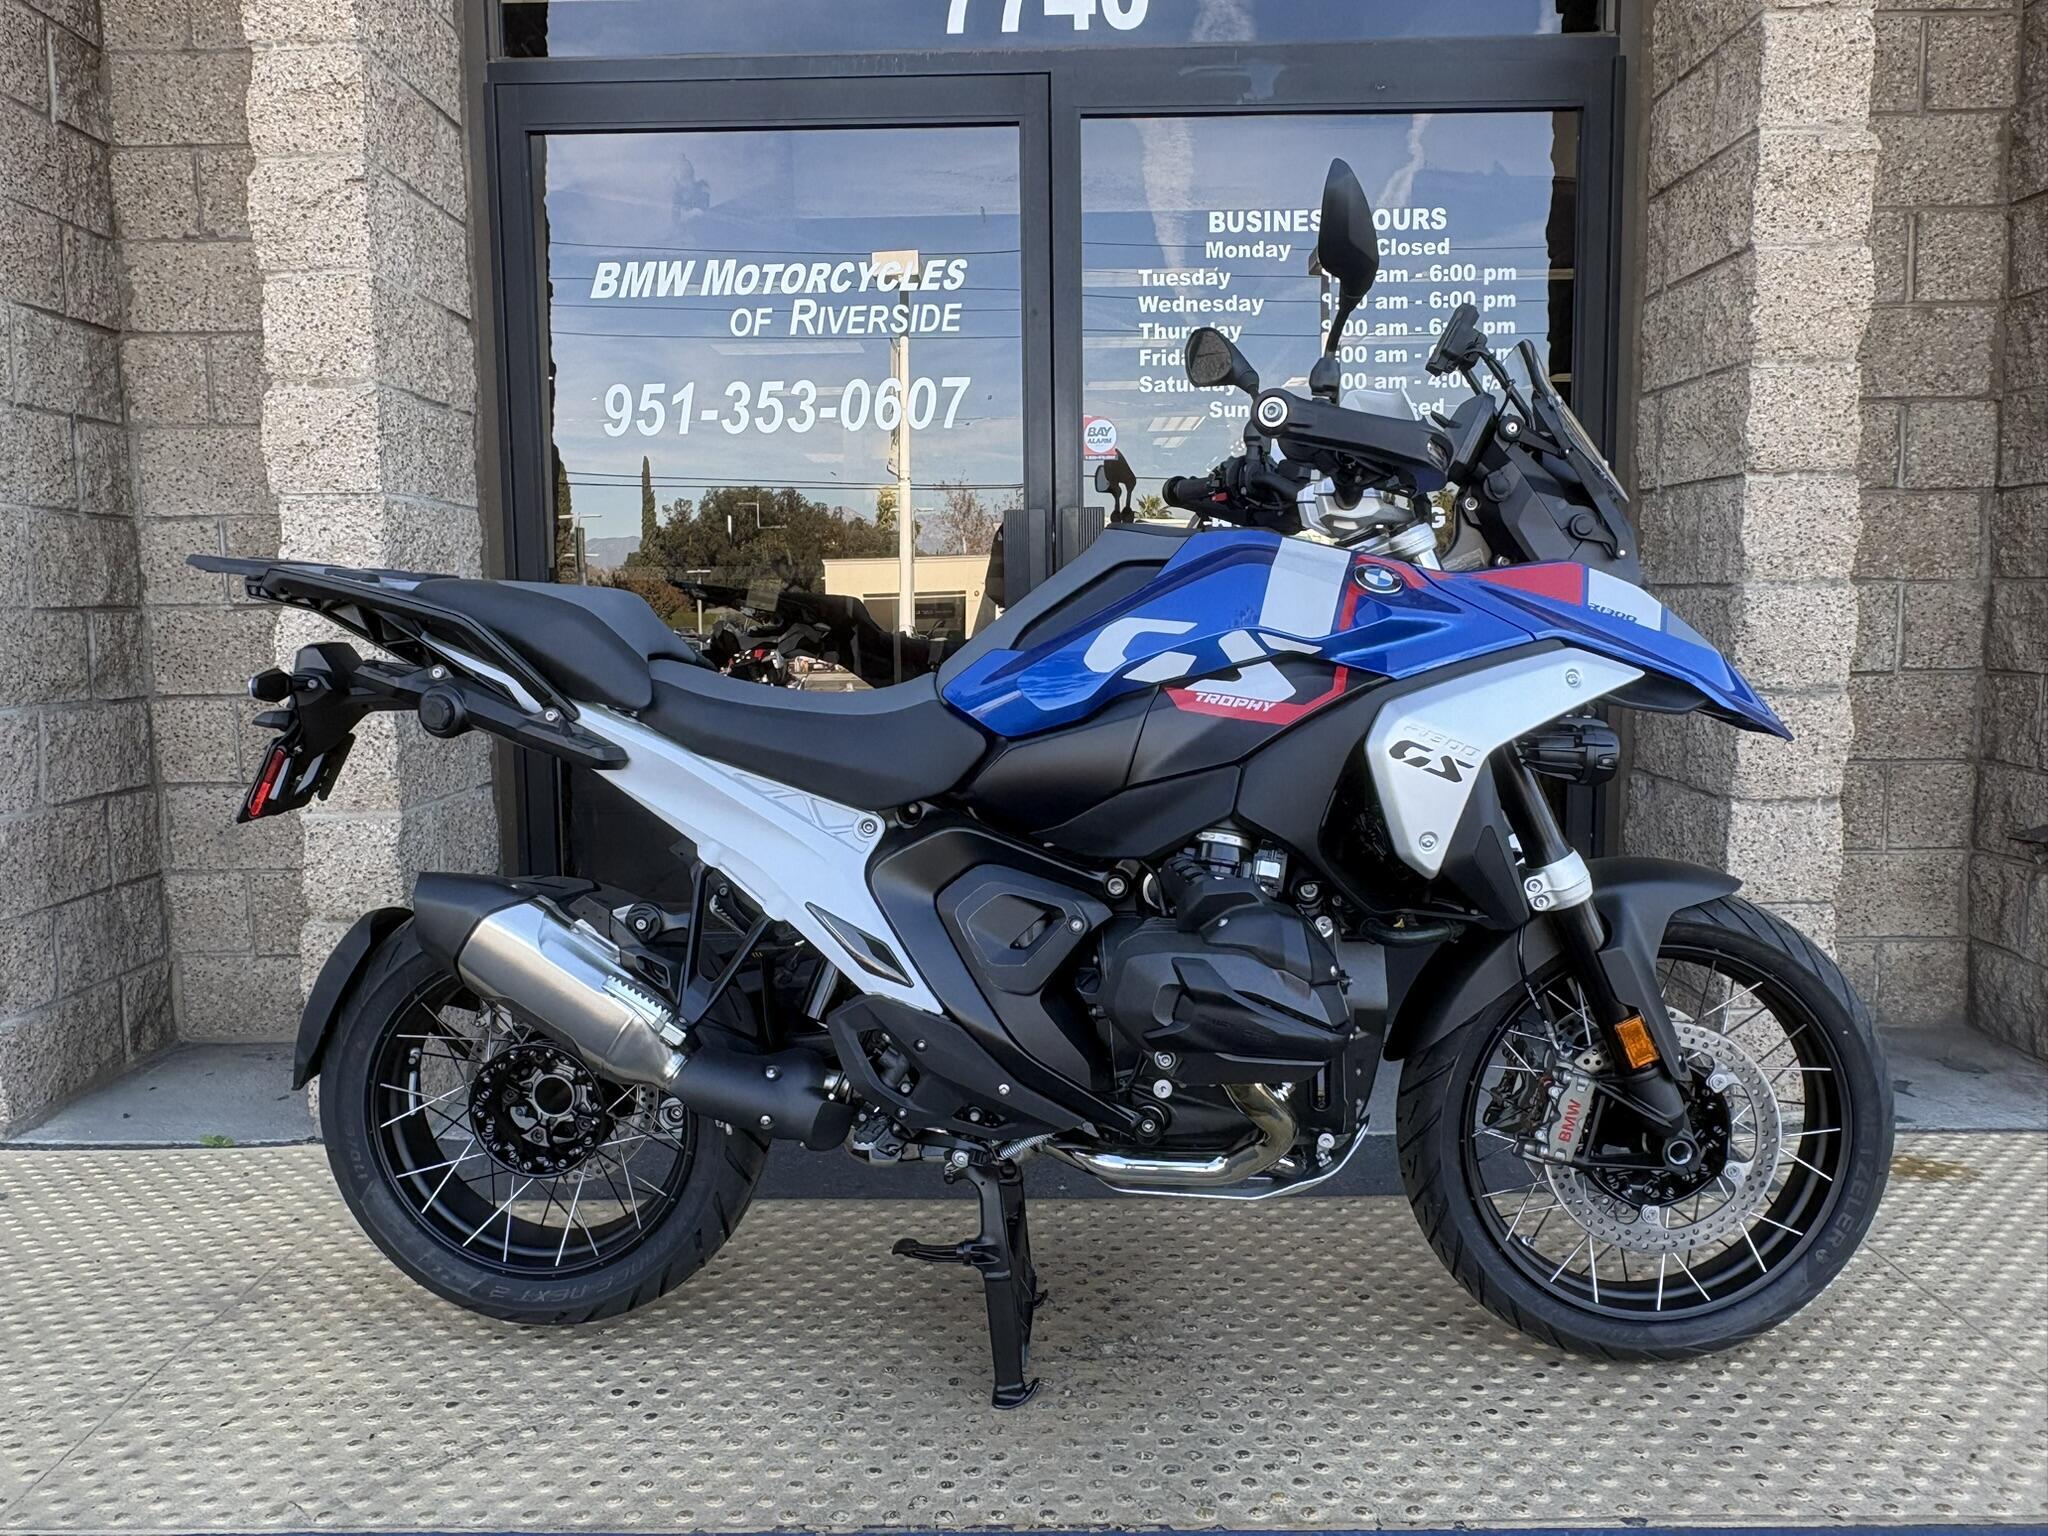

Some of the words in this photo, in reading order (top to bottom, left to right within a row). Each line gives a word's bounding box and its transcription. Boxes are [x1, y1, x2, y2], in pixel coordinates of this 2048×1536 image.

[1208, 210, 1321, 233] BUSINES
[1372, 207, 1447, 231] OURS
[1205, 240, 1291, 261] Monday
[1377, 238, 1450, 256] Closed
[590, 260, 697, 299] BMW
[699, 258, 968, 296] MOTORCYCLES
[1138, 268, 1231, 290] Tuesday
[1375, 269, 1408, 283] am
[1429, 264, 1476, 282] 6:00
[1483, 267, 1517, 285] pm
[1138, 295, 1265, 316] Wednesday
[1321, 293, 1368, 310] 9:0
[1375, 296, 1408, 310] am
[1429, 291, 1476, 309] 6:00
[1483, 293, 1517, 312] pm
[729, 307, 773, 337] OF
[789, 299, 963, 336] RIVERSIDE
[1138, 322, 1242, 343] Thuray
[1321, 319, 1368, 337] 900
[1374, 322, 1408, 336] am
[1483, 320, 1516, 337] pm
[1139, 349, 1185, 366] Frid
[1335, 346, 1368, 364] :00
[1374, 349, 1408, 363] am
[1374, 376, 1407, 390] am
[603, 377, 971, 437] 951-353-0607
[1209, 401, 1250, 418] Sun
[1087, 426, 1112, 437] BAY
[1195, 692, 1277, 712] TROPHY
[1558, 1098, 1582, 1143] BMW
